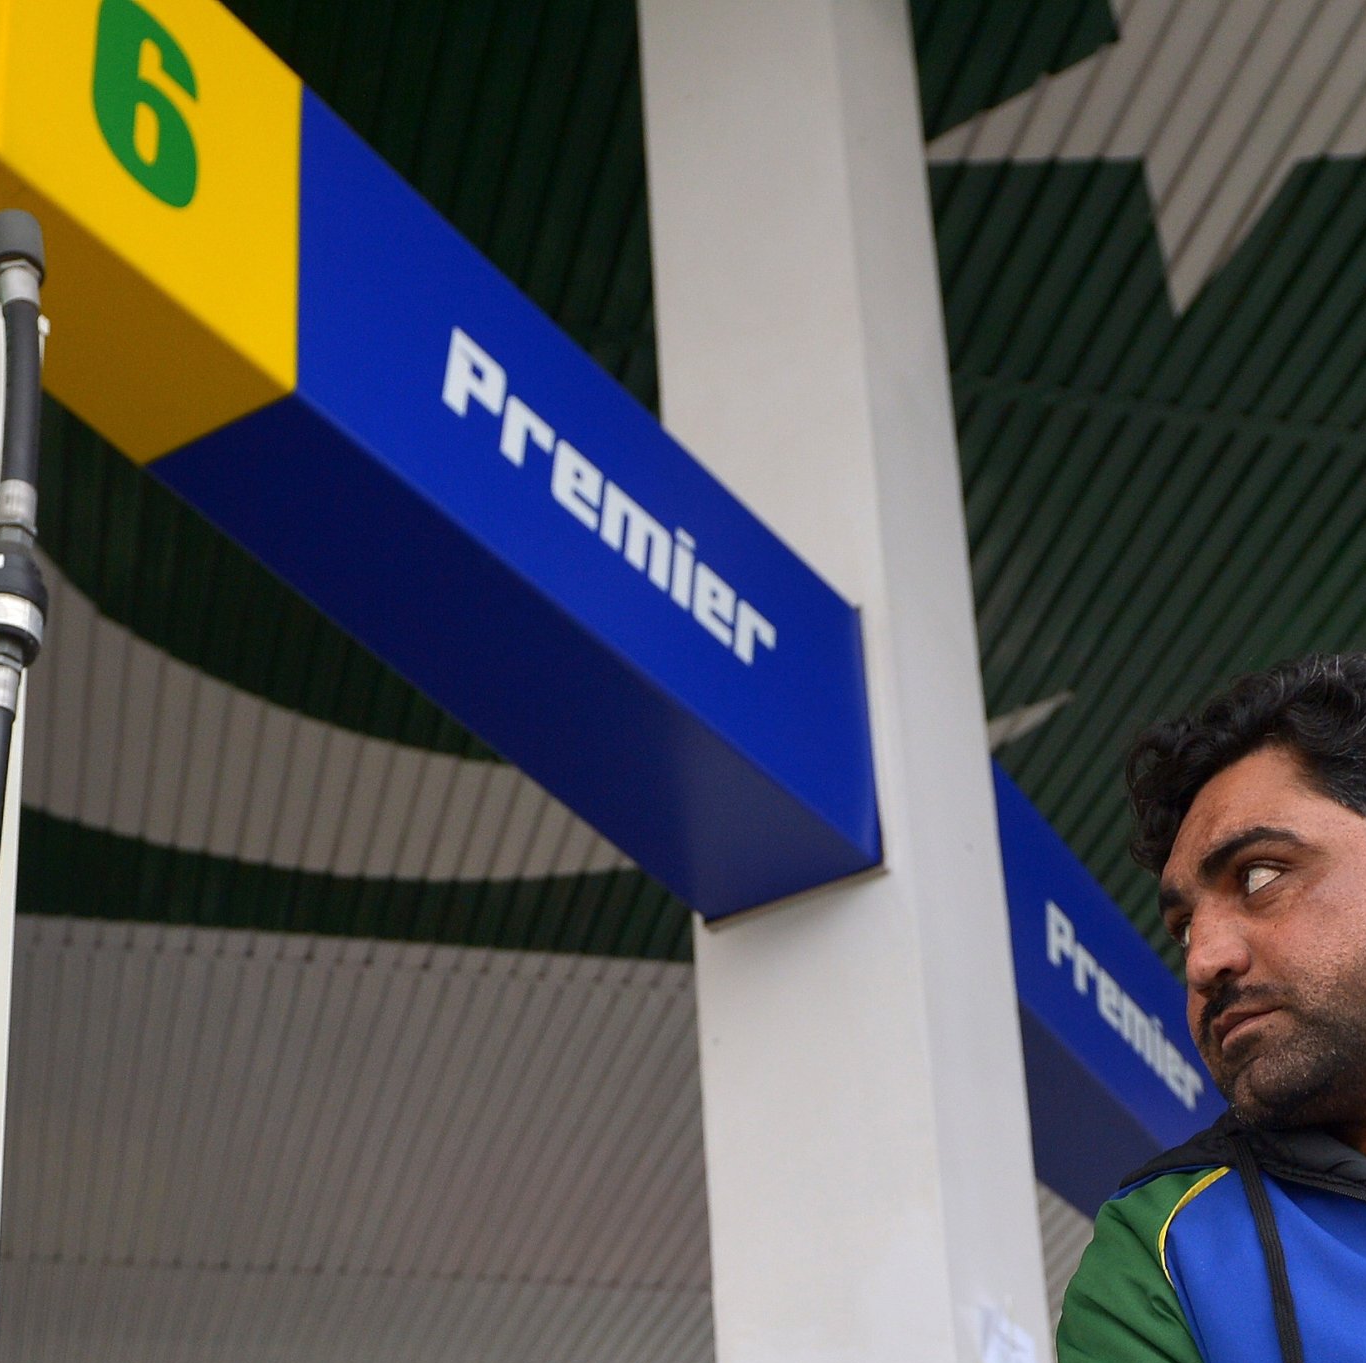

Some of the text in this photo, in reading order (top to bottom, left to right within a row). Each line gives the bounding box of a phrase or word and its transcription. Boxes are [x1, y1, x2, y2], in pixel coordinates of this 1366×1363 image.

[91, 0, 198, 208] 6
[441, 325, 777, 667] Premier
[1045, 900, 1204, 1111] Premier
